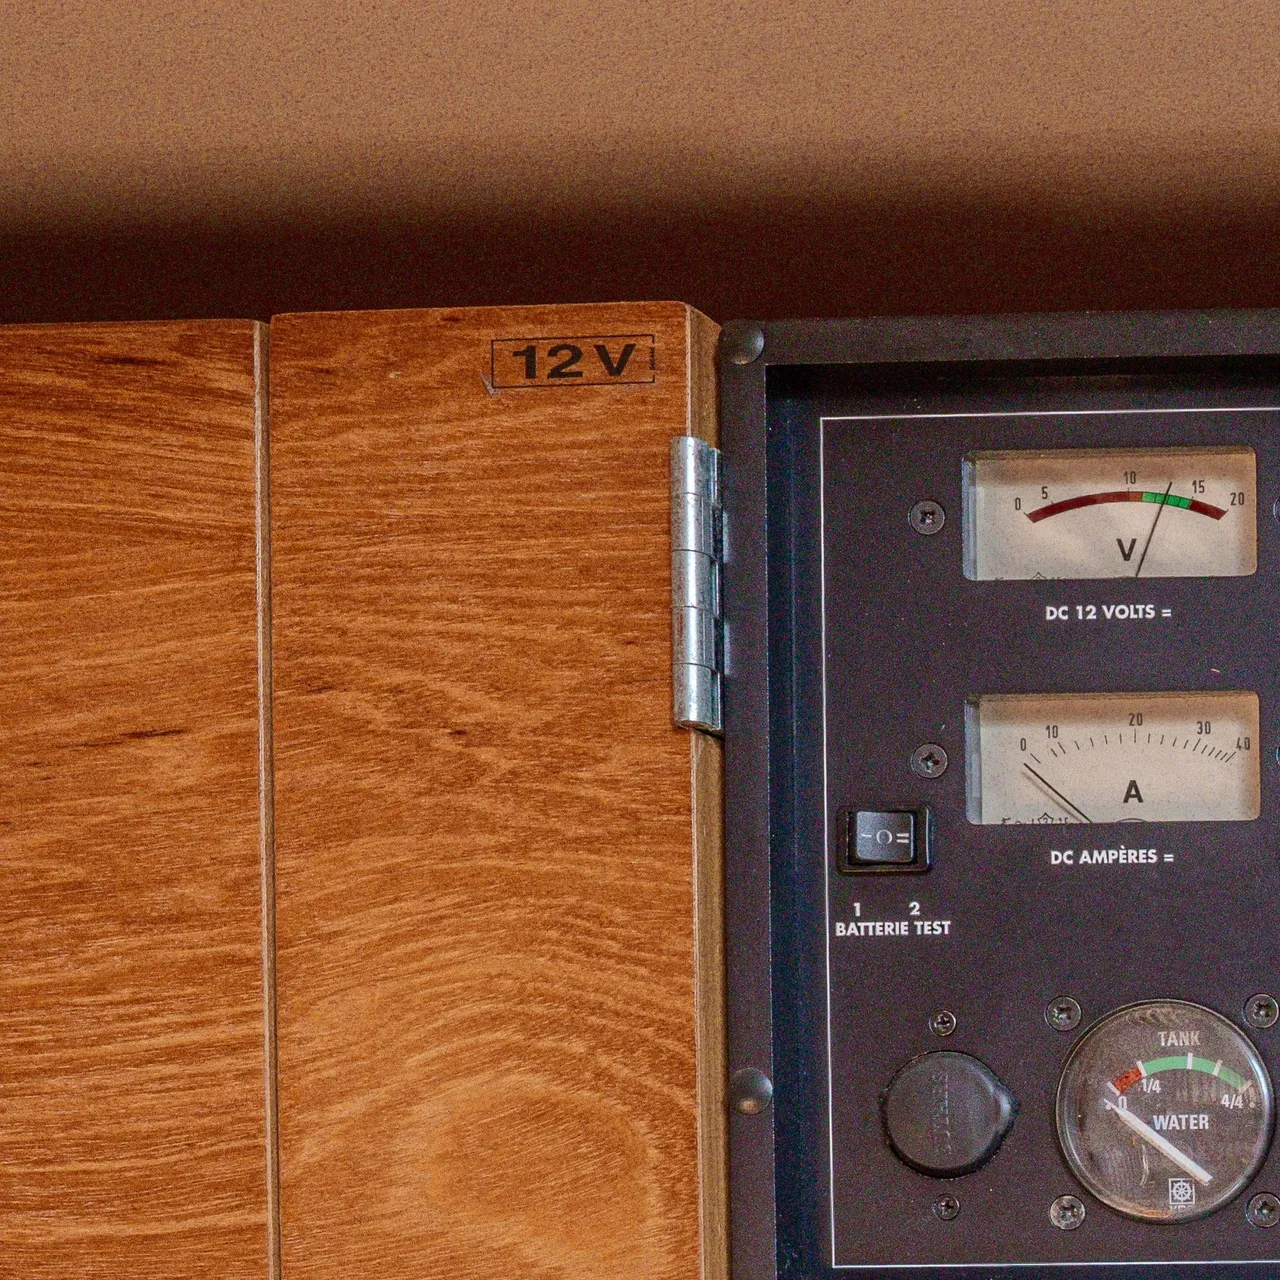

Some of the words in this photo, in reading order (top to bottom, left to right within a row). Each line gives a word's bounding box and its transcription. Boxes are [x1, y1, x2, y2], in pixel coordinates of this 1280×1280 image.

[1124, 471, 1136, 485] 10
[1193, 480, 1205, 493] 15
[1230, 493, 1244, 506] 20
[1116, 538, 1137, 561] V
[1046, 605, 1068, 620] DC
[1076, 605, 1096, 620] 12
[1102, 604, 1155, 619] VOLTS
[1129, 713, 1143, 726] 20
[1046, 726, 1058, 739] 10
[1197, 722, 1211, 734] 30
[1236, 737, 1250, 751] 40
[1123, 781, 1143, 804] A
[1051, 851, 1074, 863] DC
[1079, 845, 1157, 863] AMPÈRES
[910, 903, 920, 915] 2
[836, 922, 908, 937] BATTERIE
[914, 921, 951, 934] TEST
[1158, 1031, 1200, 1047] TANK
[1142, 1079, 1161, 1093] 1/4
[1221, 1094, 1244, 1110] 4/4
[1153, 1114, 1209, 1130] WATER
